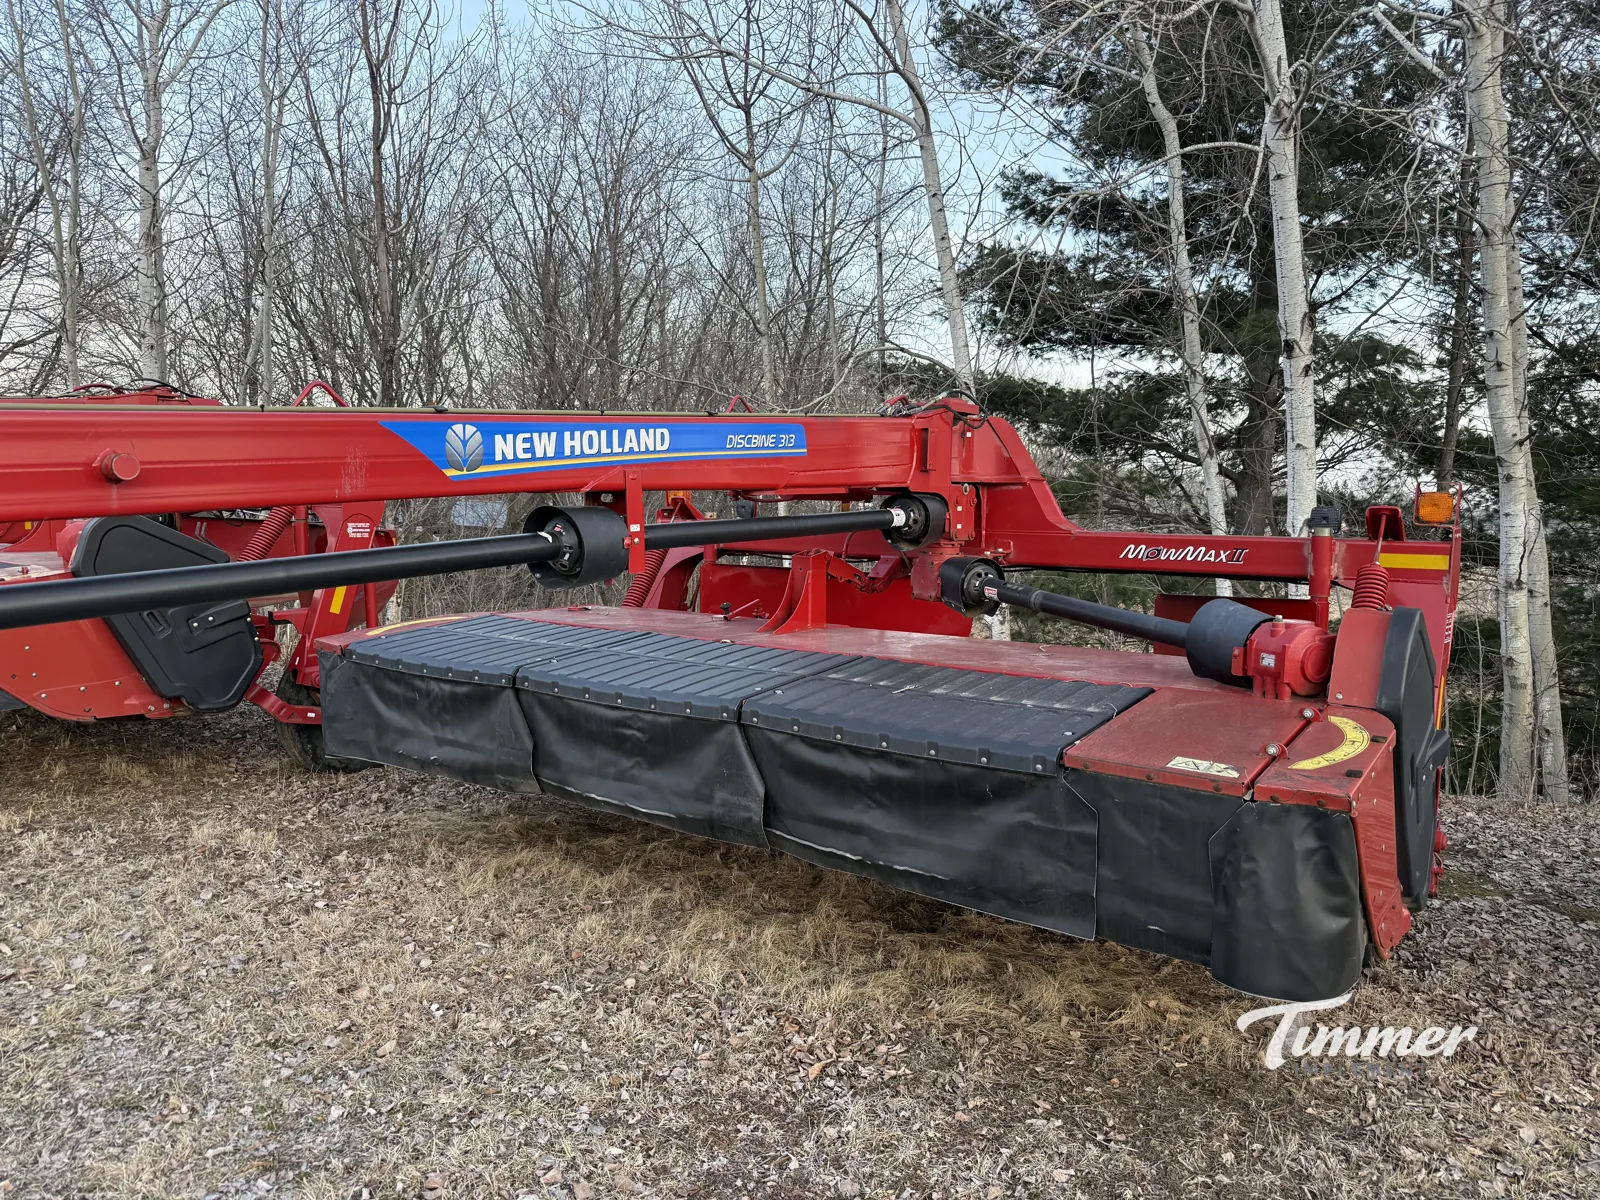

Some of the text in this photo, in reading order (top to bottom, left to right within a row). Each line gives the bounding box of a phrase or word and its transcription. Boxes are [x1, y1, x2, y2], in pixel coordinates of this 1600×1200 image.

[494, 427, 671, 462] NEW HOLLAND
[726, 434, 796, 448] DISCBINE 313
